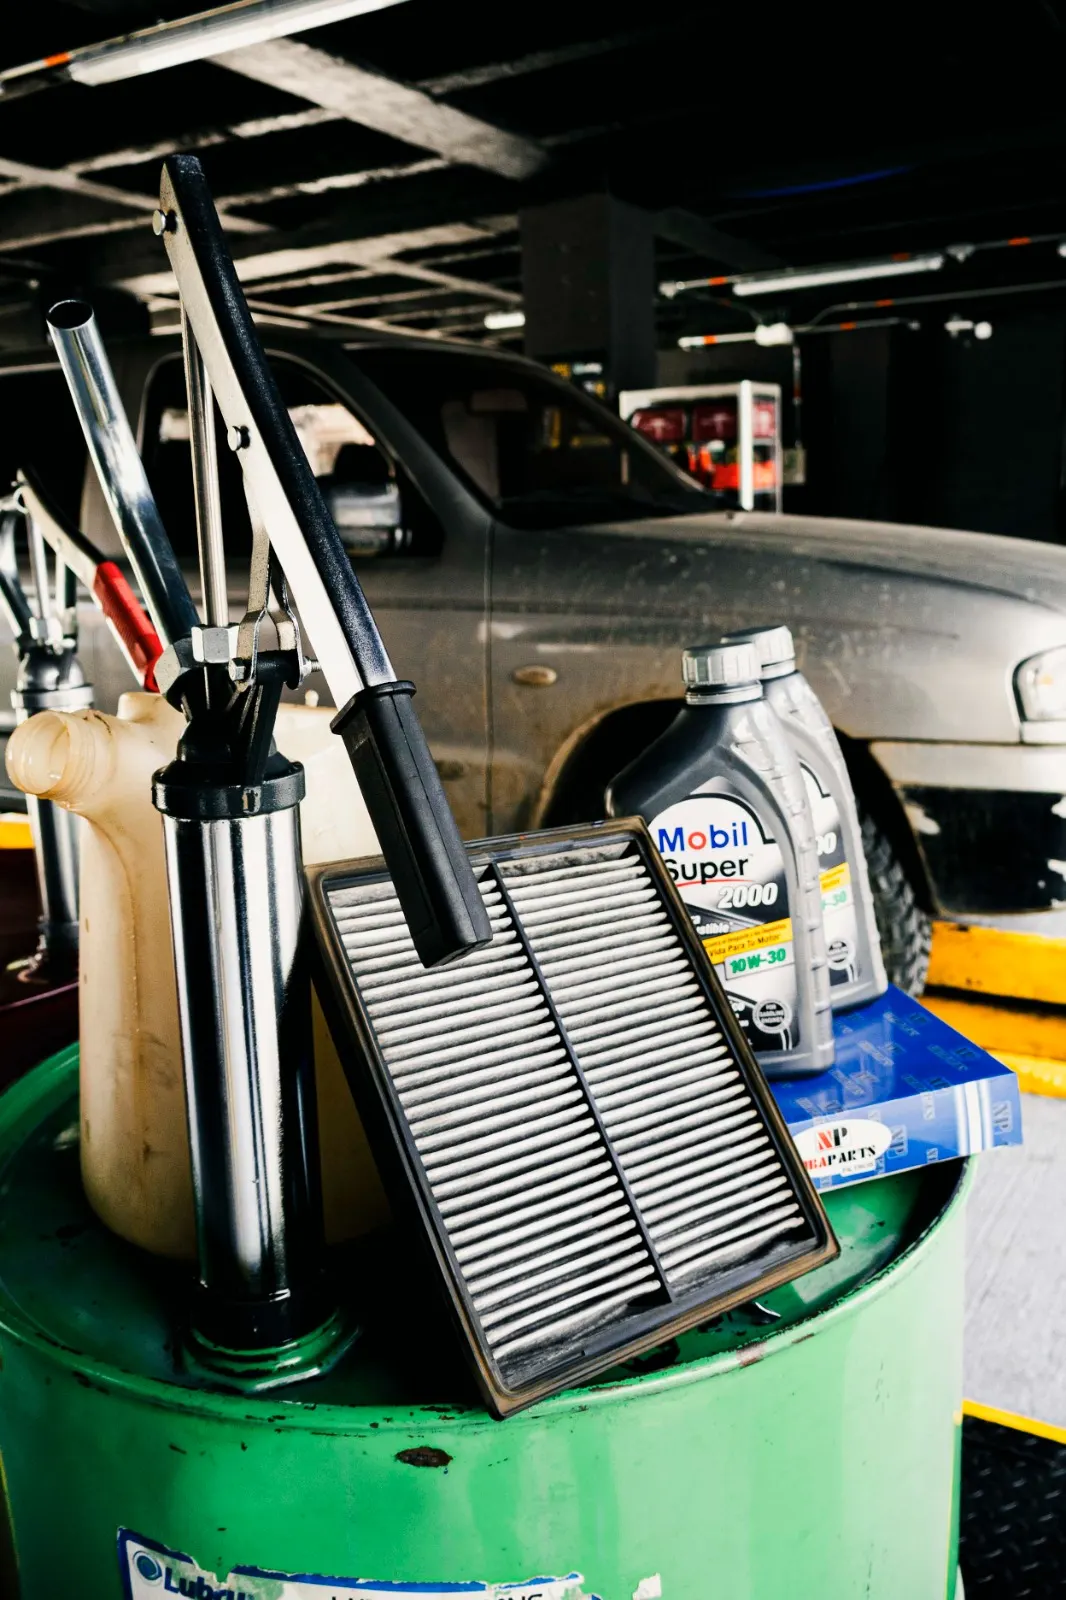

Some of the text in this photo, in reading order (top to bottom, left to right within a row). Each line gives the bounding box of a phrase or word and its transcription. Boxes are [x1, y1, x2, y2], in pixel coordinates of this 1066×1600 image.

[658, 821, 748, 853] Mobil
[664, 858, 749, 885] Super
[718, 882, 778, 909] 2000
[730, 948, 786, 974] 10W-30
[818, 1127, 848, 1150] NP
